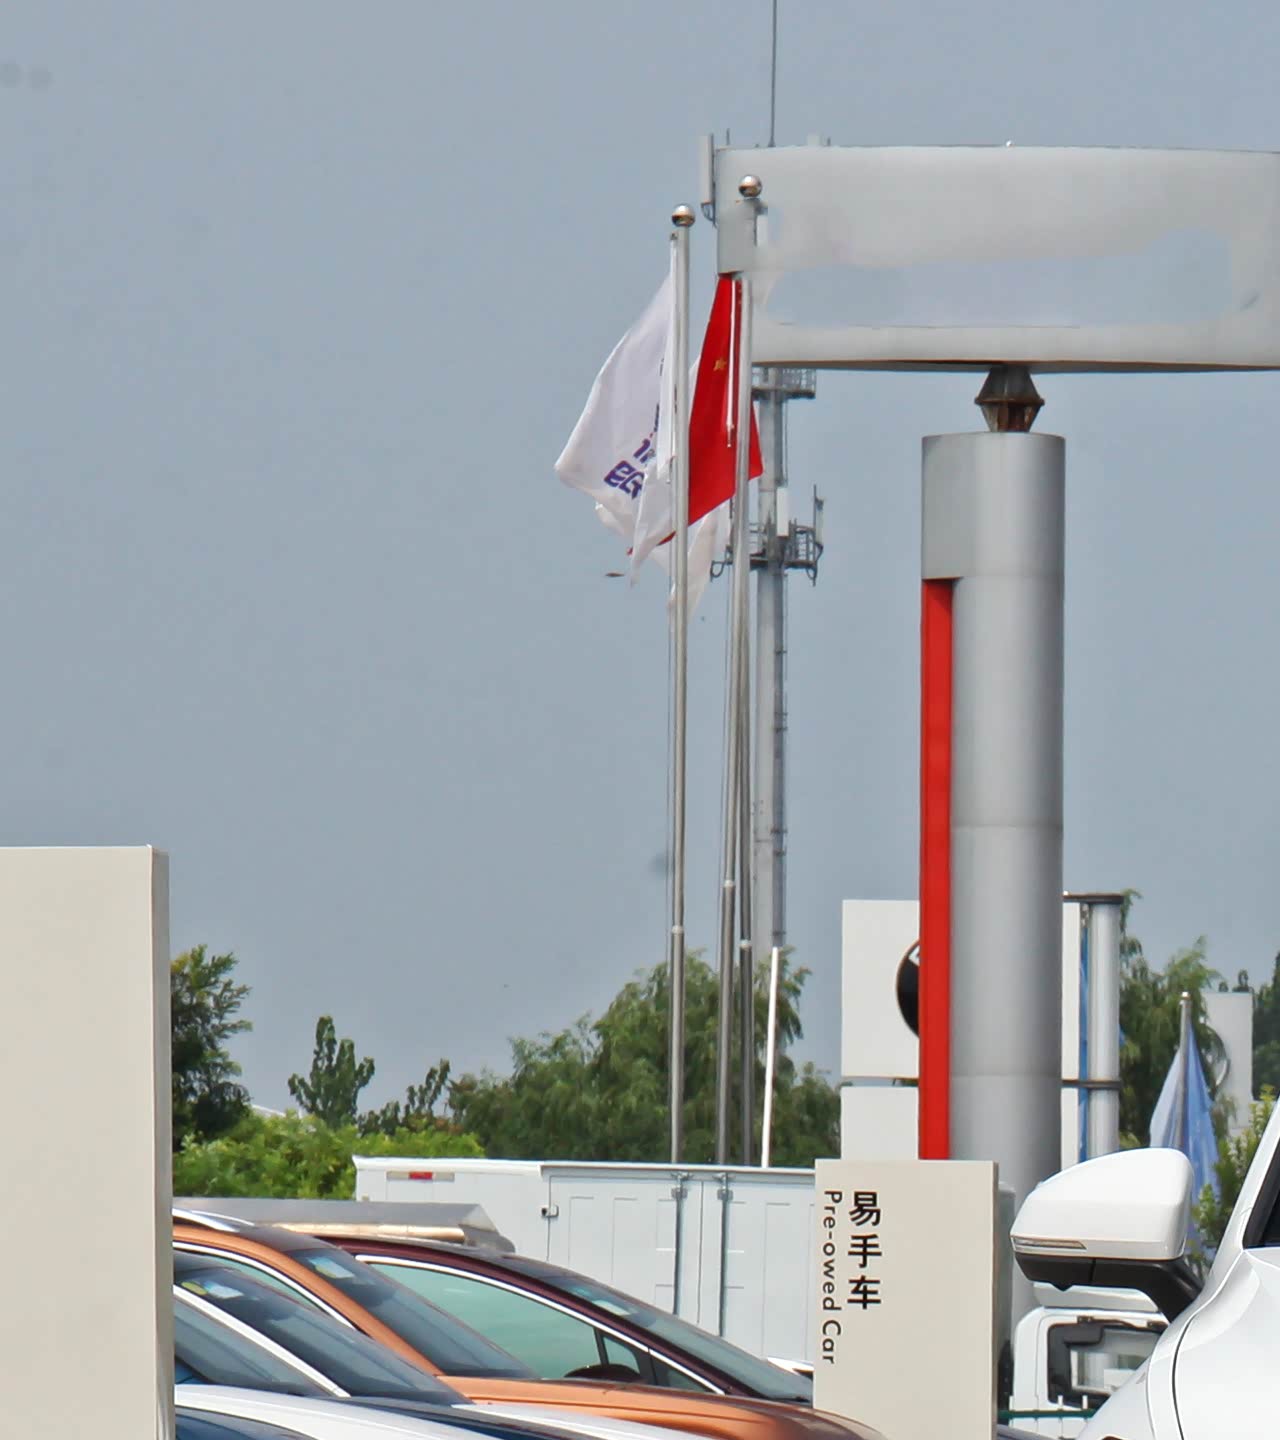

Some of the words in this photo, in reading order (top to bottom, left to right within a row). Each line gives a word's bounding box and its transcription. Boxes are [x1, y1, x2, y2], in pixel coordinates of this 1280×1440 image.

[822, 1190, 843, 1311] Pre-owed
[847, 1190, 883, 1310] 易手车
[822, 1319, 842, 1365] Car
